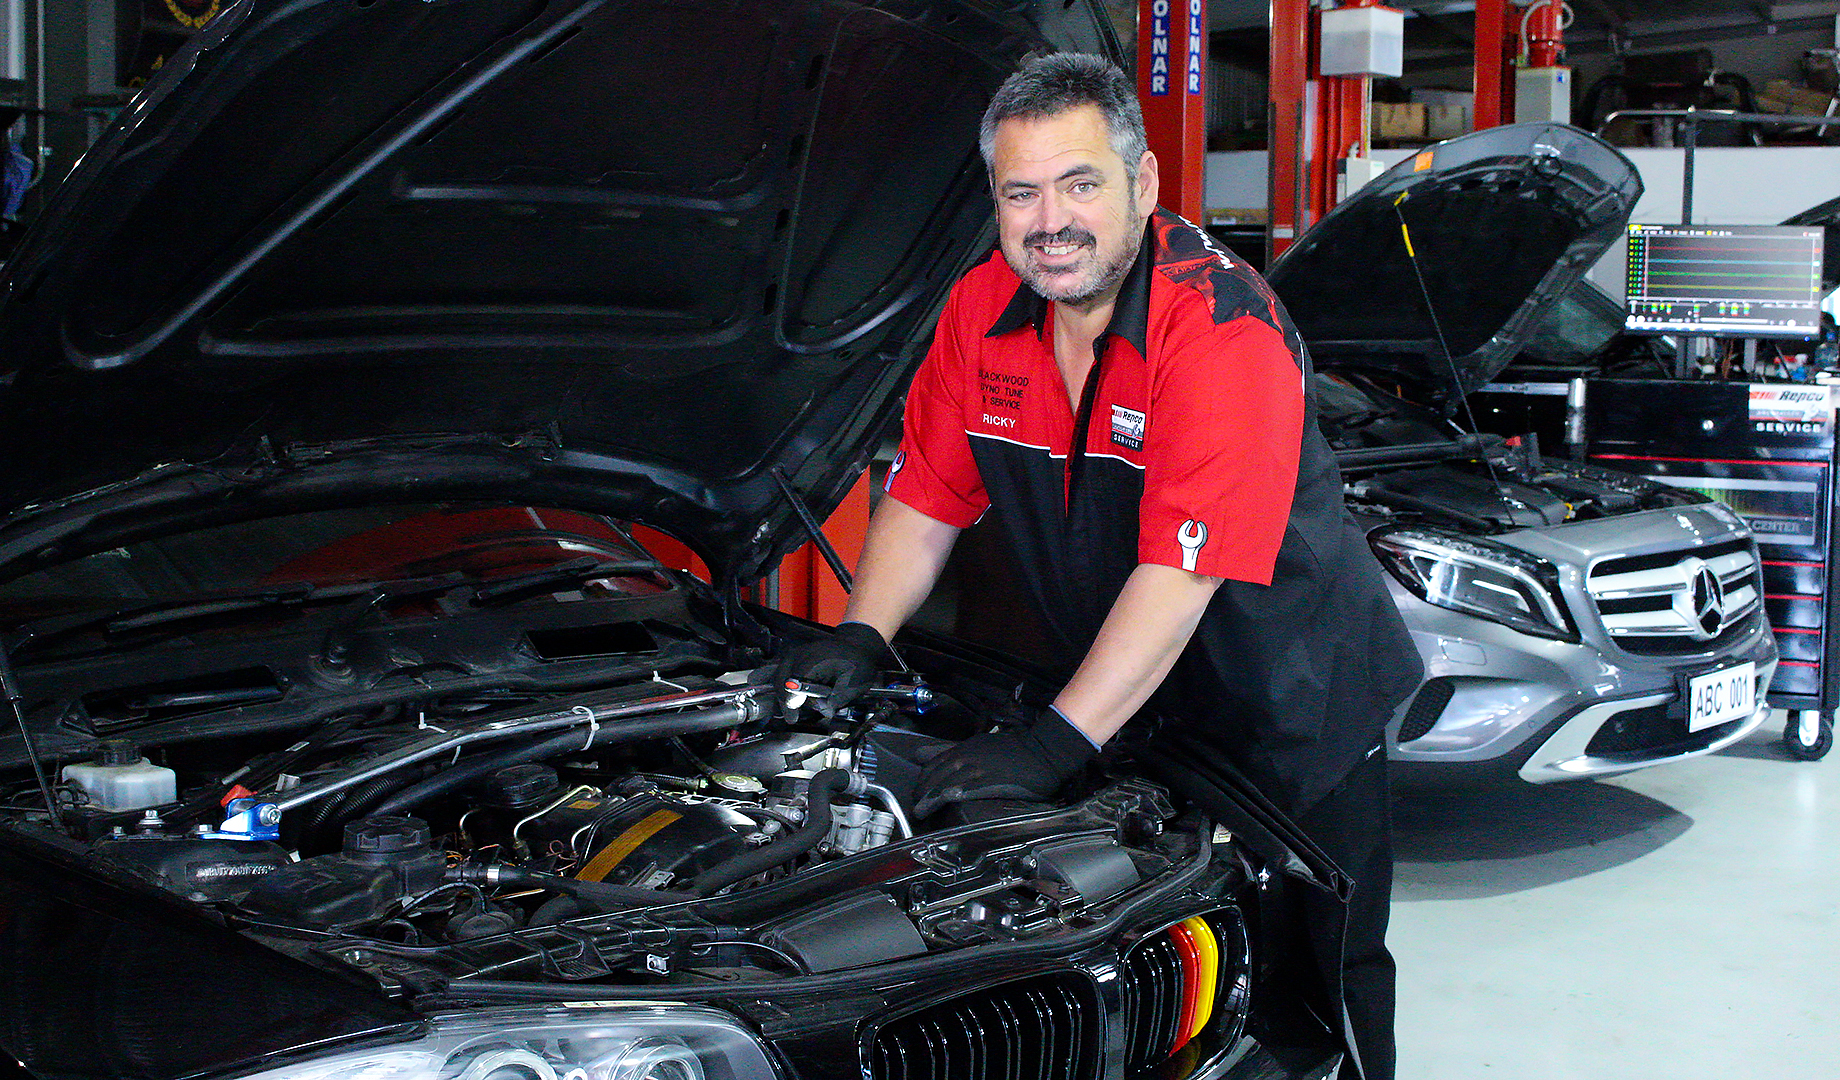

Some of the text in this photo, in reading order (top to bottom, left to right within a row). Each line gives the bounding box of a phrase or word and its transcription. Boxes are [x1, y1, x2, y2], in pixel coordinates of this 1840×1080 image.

[980, 382, 1024, 398] DYNO TUNE
[990, 396, 1020, 410] SERVICE
[982, 413, 1016, 428] RICKY
[1756, 422, 1821, 433] SERVICE
[1113, 433, 1139, 449] SERVICE
[1694, 674, 1748, 720] ABC 001
